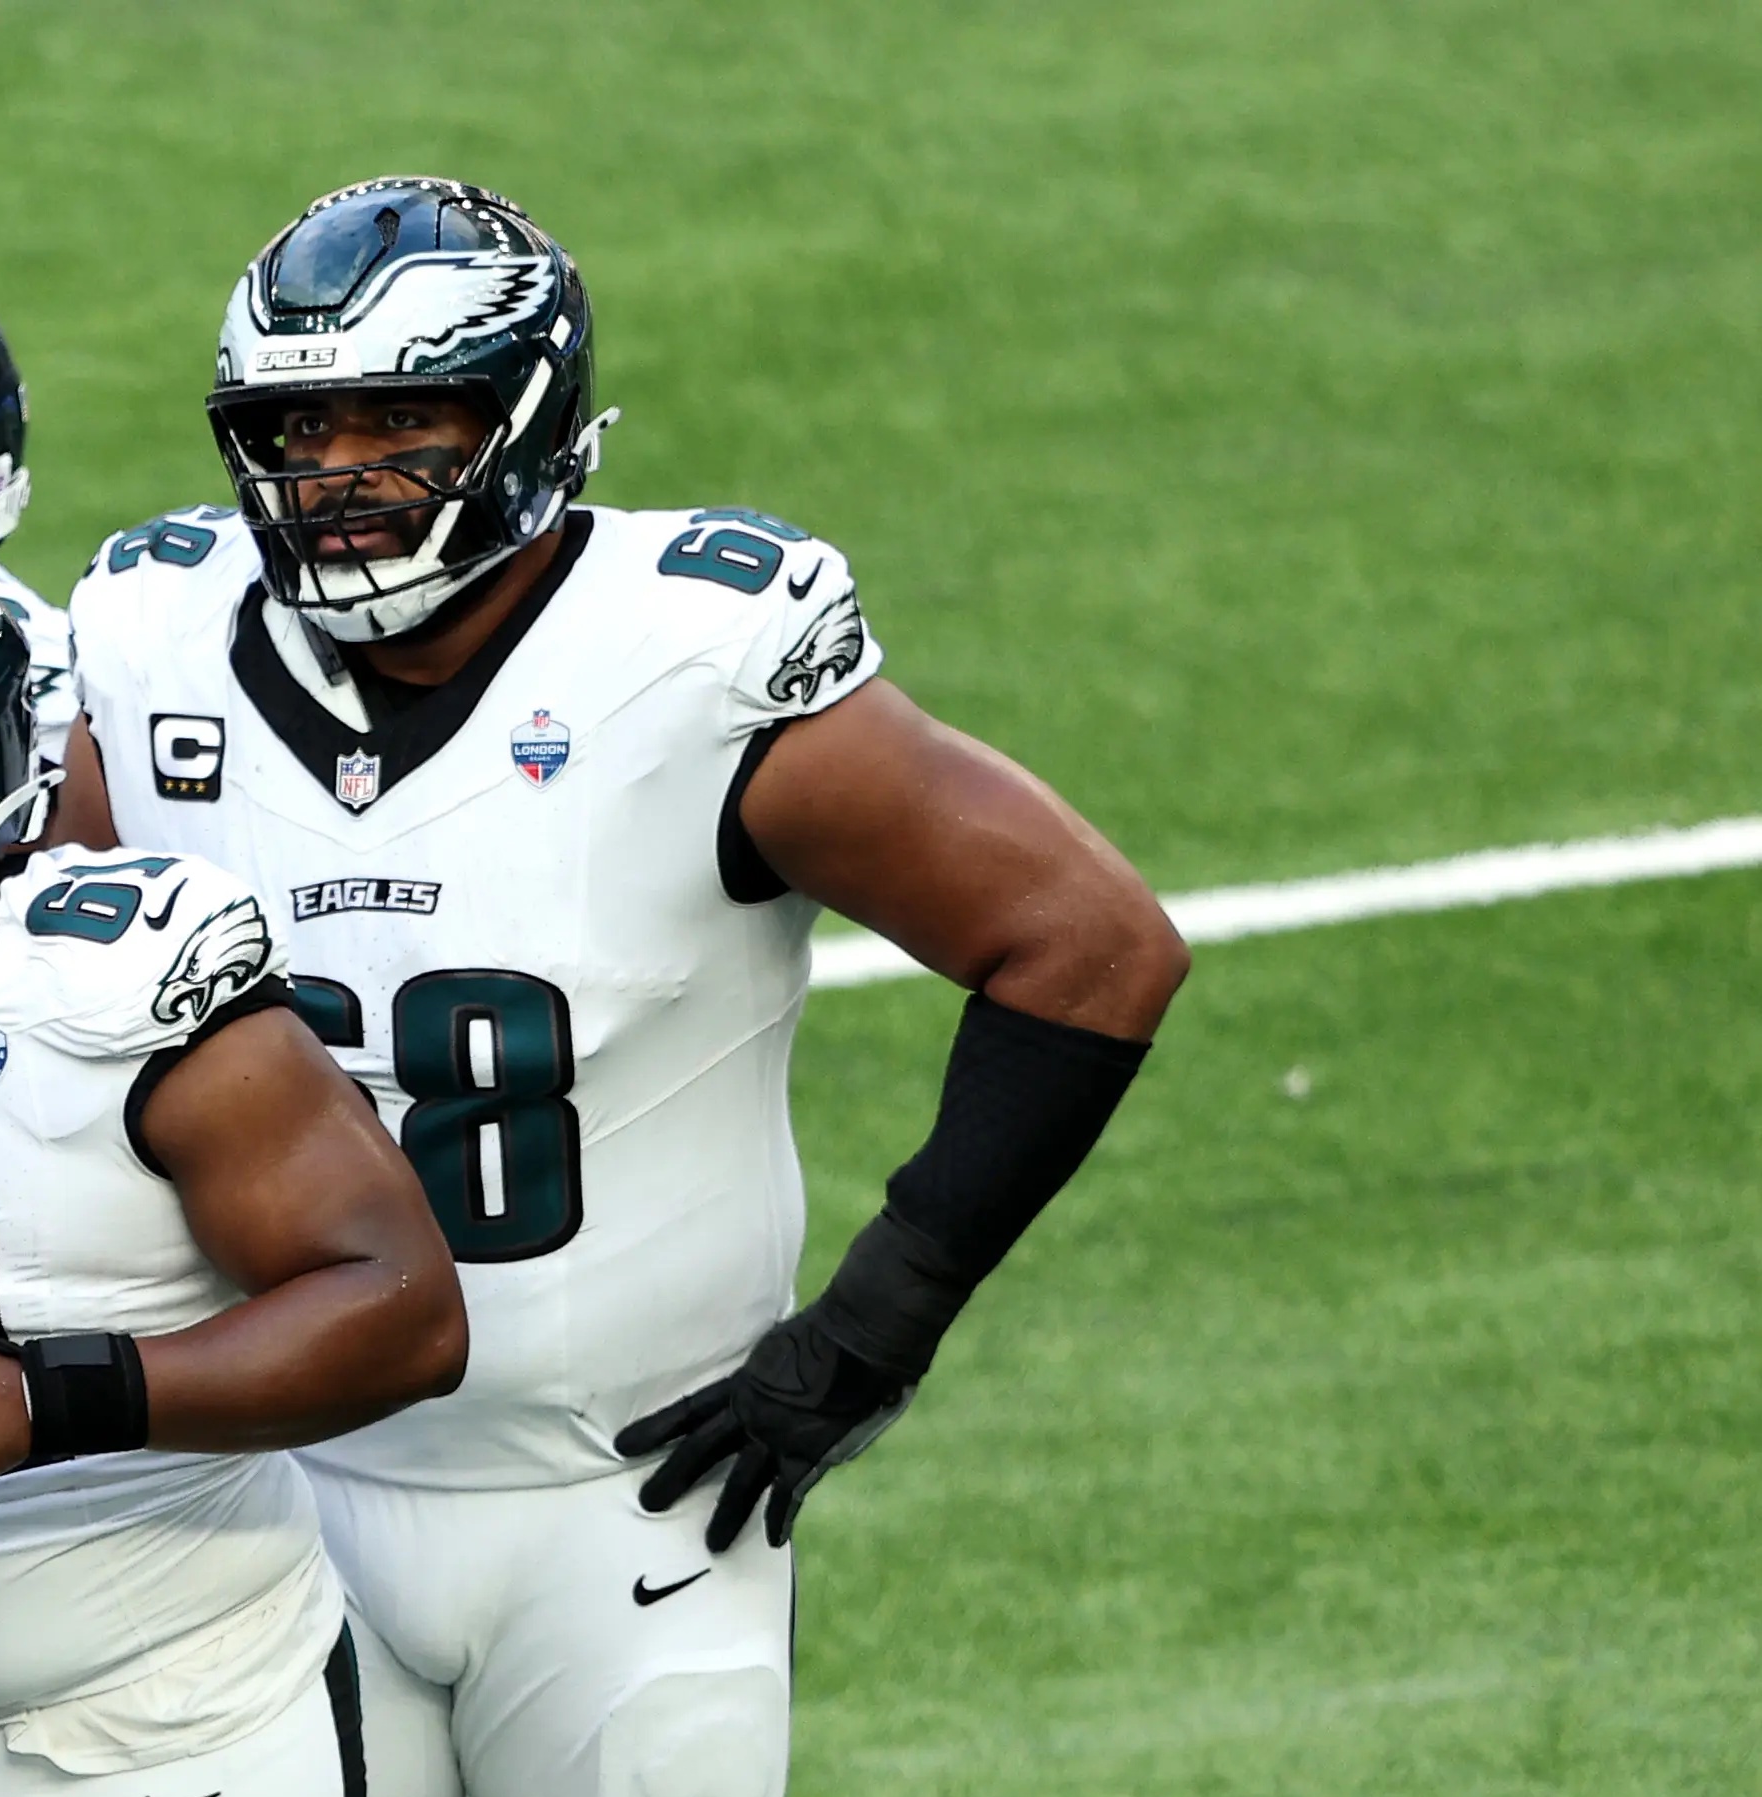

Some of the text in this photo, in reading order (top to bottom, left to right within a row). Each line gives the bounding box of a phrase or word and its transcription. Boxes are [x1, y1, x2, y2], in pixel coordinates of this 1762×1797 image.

[256, 348, 337, 372] EAGLES
[153, 729, 222, 779] C
[515, 744, 566, 756] LONDON
[342, 777, 371, 798] NFL
[291, 879, 443, 922] EAGLES
